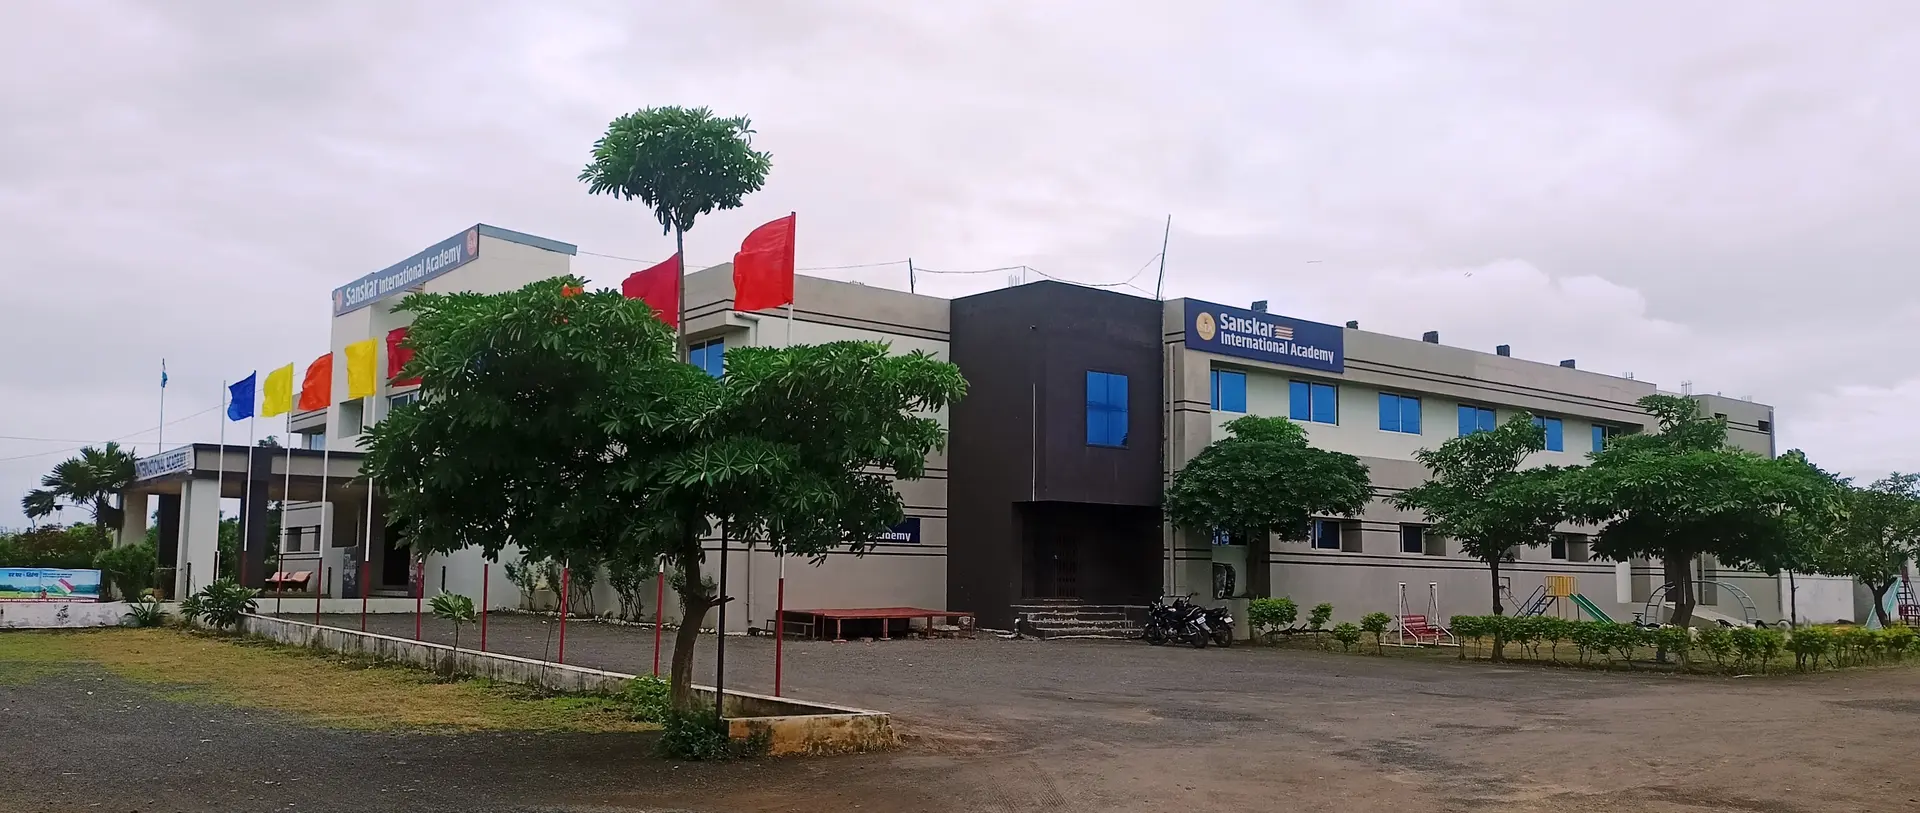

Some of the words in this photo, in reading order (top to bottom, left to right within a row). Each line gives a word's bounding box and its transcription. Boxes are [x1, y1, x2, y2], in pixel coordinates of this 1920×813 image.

[346, 278, 378, 307] Sanskar
[379, 259, 425, 294] International
[425, 243, 462, 274] Academy
[1220, 312, 1274, 338] Sanskar
[1220, 331, 1288, 355] International
[1290, 343, 1334, 364] Academy
